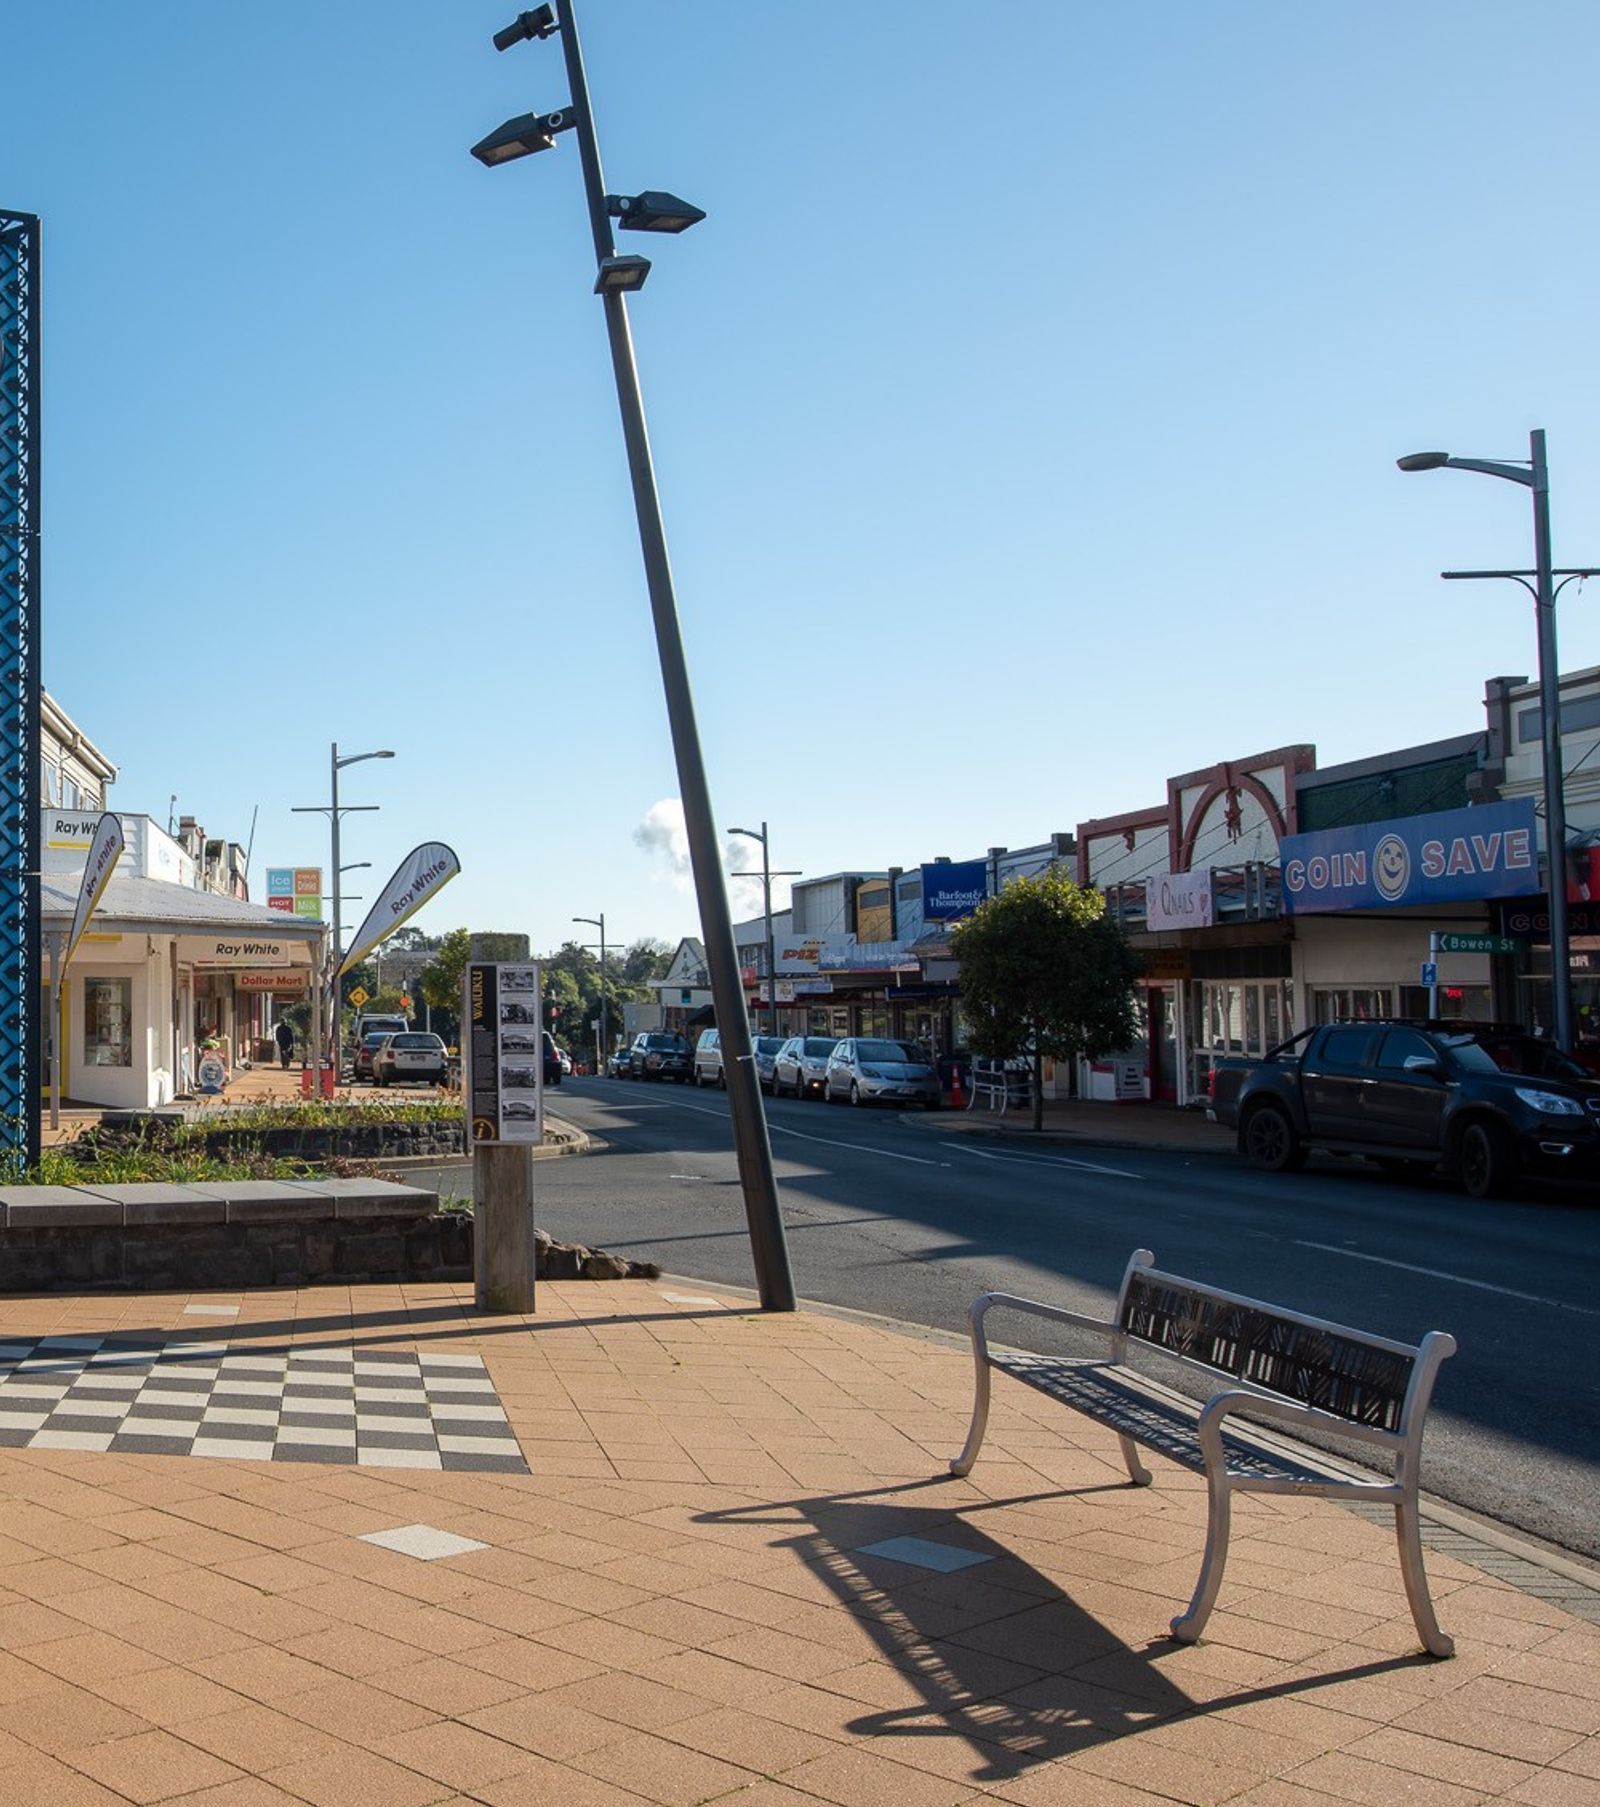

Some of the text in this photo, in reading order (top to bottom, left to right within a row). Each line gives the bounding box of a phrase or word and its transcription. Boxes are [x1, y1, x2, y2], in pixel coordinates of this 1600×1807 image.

[55, 819, 80, 836] Ray
[1285, 828, 1532, 892] COIN SAVE
[390, 860, 447, 915] Ray White
[929, 897, 980, 909] Thompson
[1509, 912, 1588, 932] CON
[216, 943, 280, 956] Ray White
[1450, 937, 1514, 950] Bowen St
[782, 949, 819, 960] PIZ
[241, 976, 303, 985] Dollar Mart
